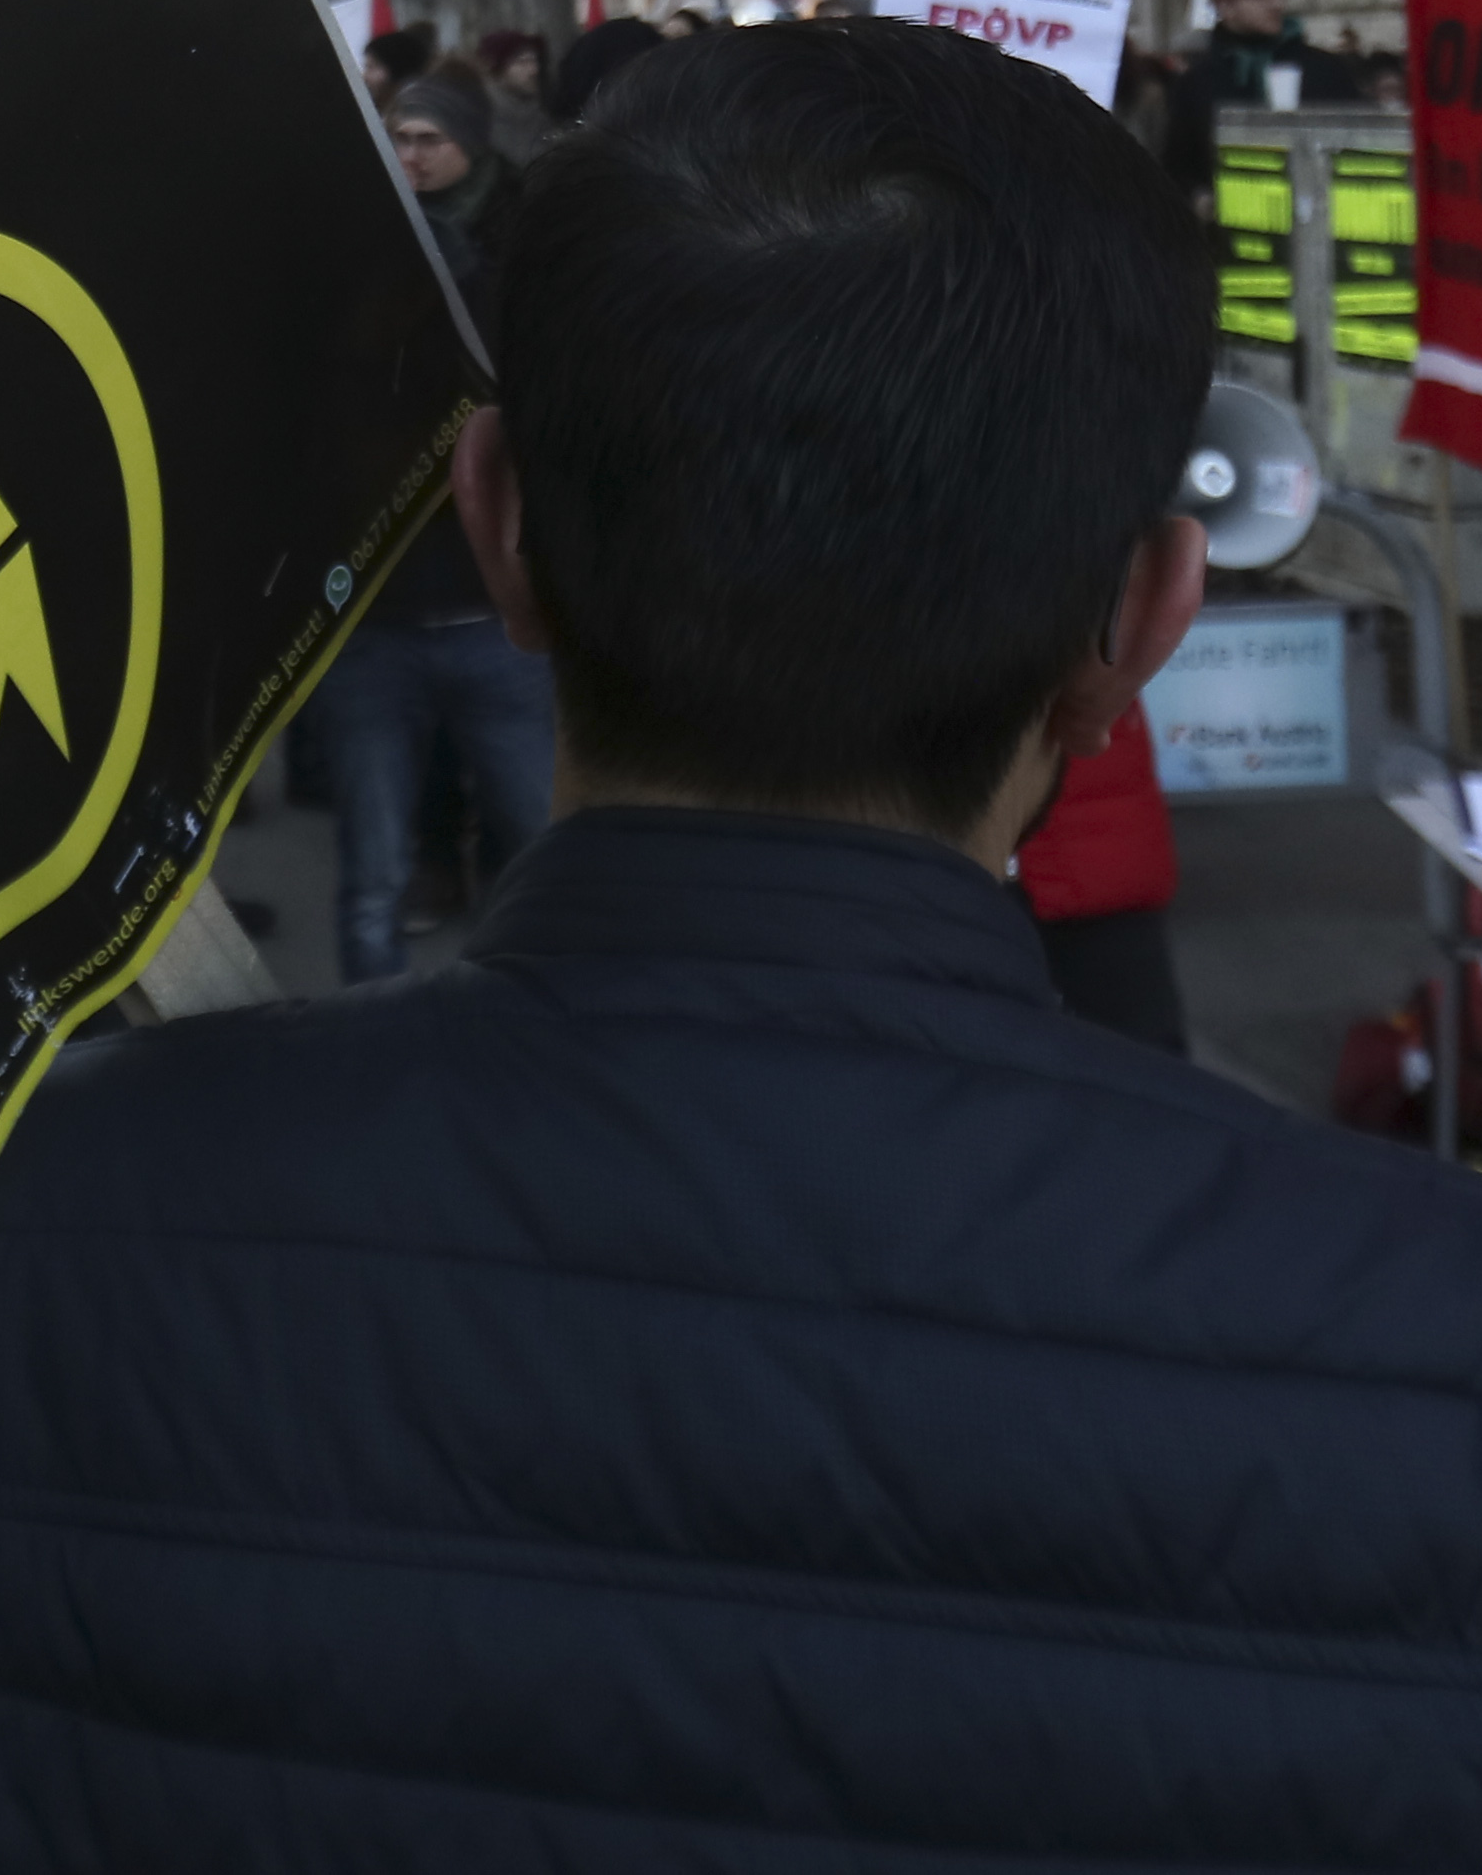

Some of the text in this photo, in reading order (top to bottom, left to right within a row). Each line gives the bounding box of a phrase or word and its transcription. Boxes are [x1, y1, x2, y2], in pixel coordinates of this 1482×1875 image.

[196, 673, 283, 817] Linkswende
[277, 609, 326, 681] jetzt!
[350, 507, 391, 572] 0677
[392, 453, 434, 514] 6263
[16, 857, 178, 1037] linkswende.org
